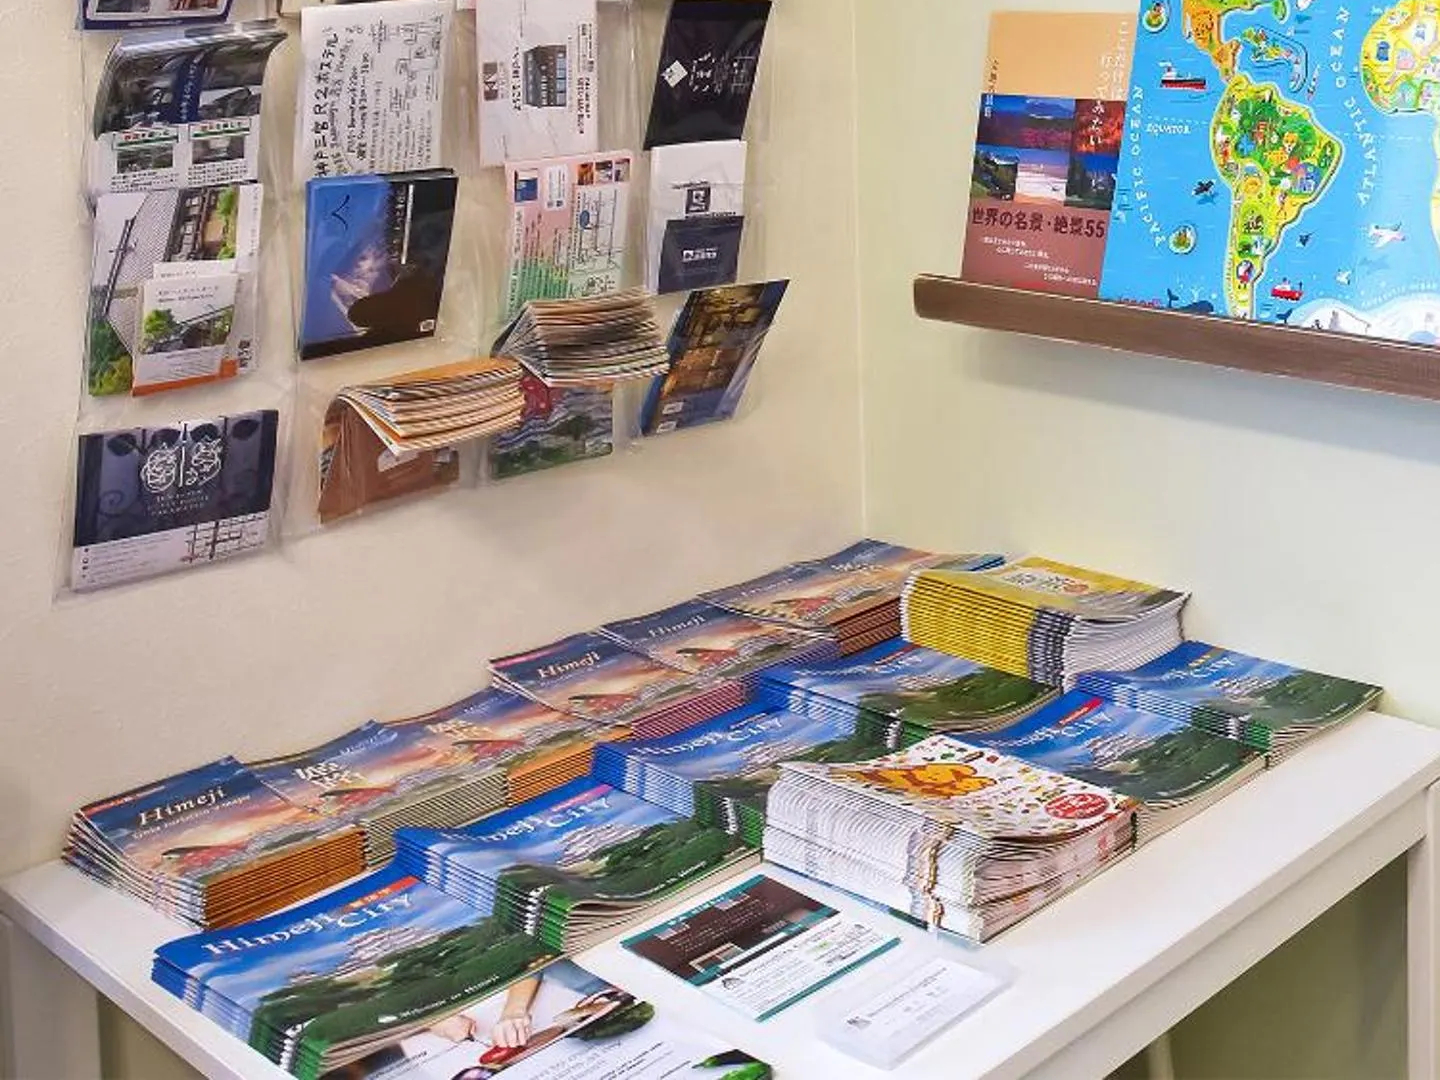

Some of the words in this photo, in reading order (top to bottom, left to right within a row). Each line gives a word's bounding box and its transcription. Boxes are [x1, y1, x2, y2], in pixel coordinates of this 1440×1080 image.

[1330, 6, 1351, 89] OCEAN
[1130, 85, 1144, 156] OCEAN
[537, 651, 601, 679] Himeji
[137, 786, 226, 826] Himeji
[201, 912, 340, 956] Himeji
